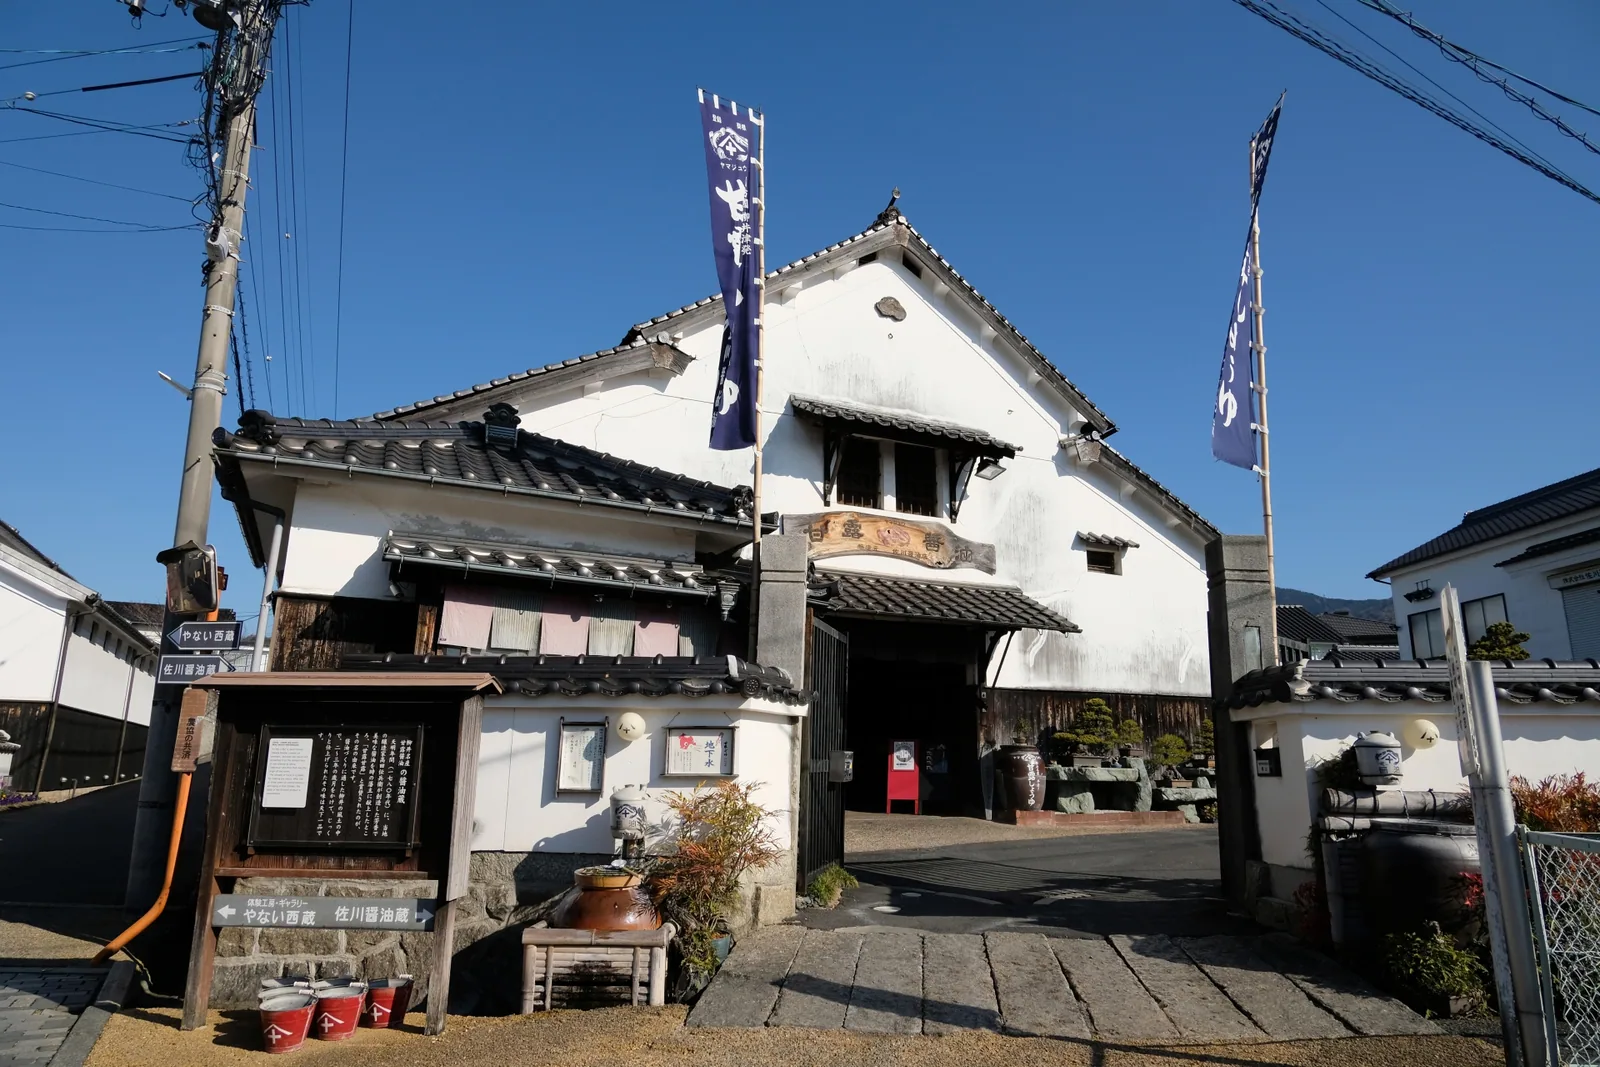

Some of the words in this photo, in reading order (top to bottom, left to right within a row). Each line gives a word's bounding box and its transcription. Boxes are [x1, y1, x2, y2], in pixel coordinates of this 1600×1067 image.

[182, 630, 235, 642] やない西蔵
[163, 663, 217, 676] 佐川醤油蔵
[181, 717, 197, 760] 農協の共済
[704, 740, 715, 768] 地下水
[243, 908, 316, 926] やない西蔵
[334, 905, 410, 923] 佐川醤油蔵
